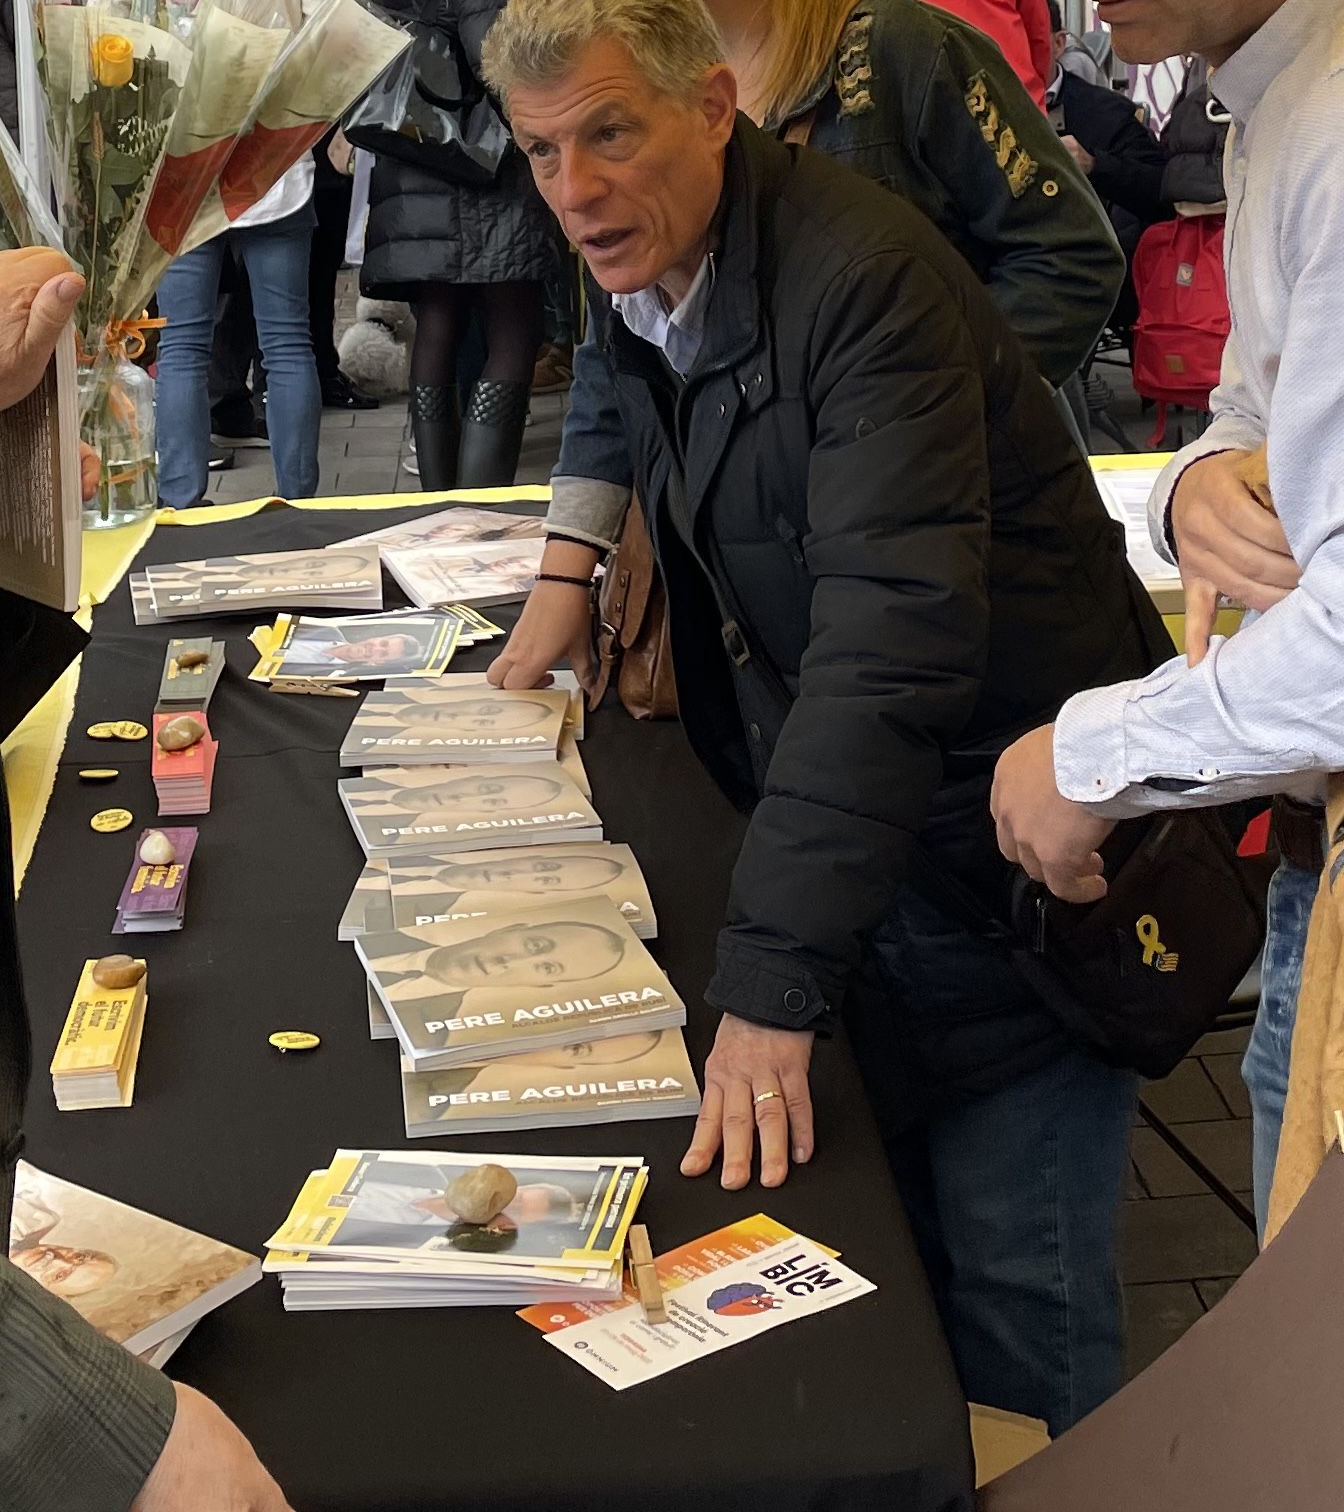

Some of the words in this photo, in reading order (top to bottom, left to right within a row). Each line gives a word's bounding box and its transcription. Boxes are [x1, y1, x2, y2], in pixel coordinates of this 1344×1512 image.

[214, 587, 267, 596] PERE
[271, 579, 373, 593] AGUILERA
[361, 736, 422, 746] PERE
[428, 735, 547, 746] AGUILERA
[381, 824, 449, 836] PERE
[456, 811, 585, 832] AGUILERA
[424, 1011, 506, 1034] PERE
[513, 986, 663, 1023] AGUILERA
[428, 1090, 511, 1108] PERE
[520, 1076, 684, 1101] AGUILERA
